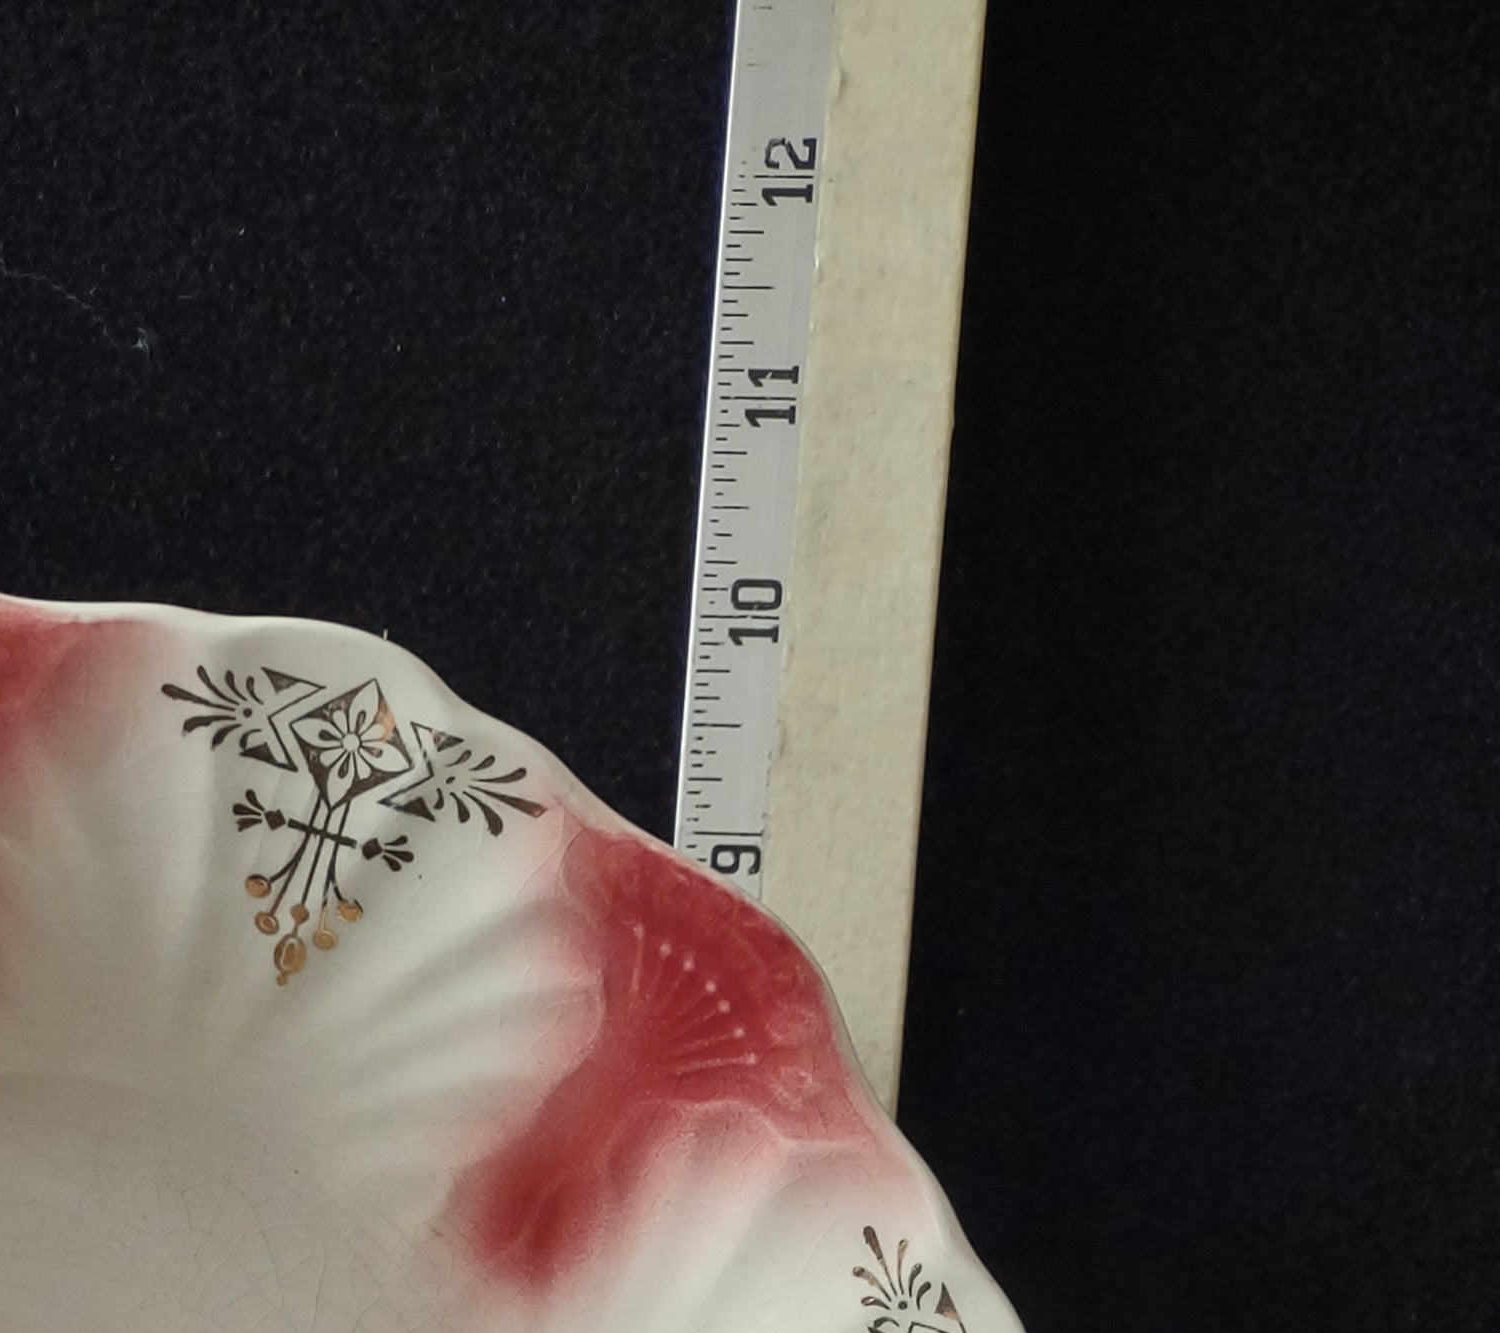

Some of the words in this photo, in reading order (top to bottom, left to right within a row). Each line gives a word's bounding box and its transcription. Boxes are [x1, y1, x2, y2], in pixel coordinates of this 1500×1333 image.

[761, 137, 817, 206] 12
[744, 365, 800, 428] 11
[728, 578, 783, 646] 10
